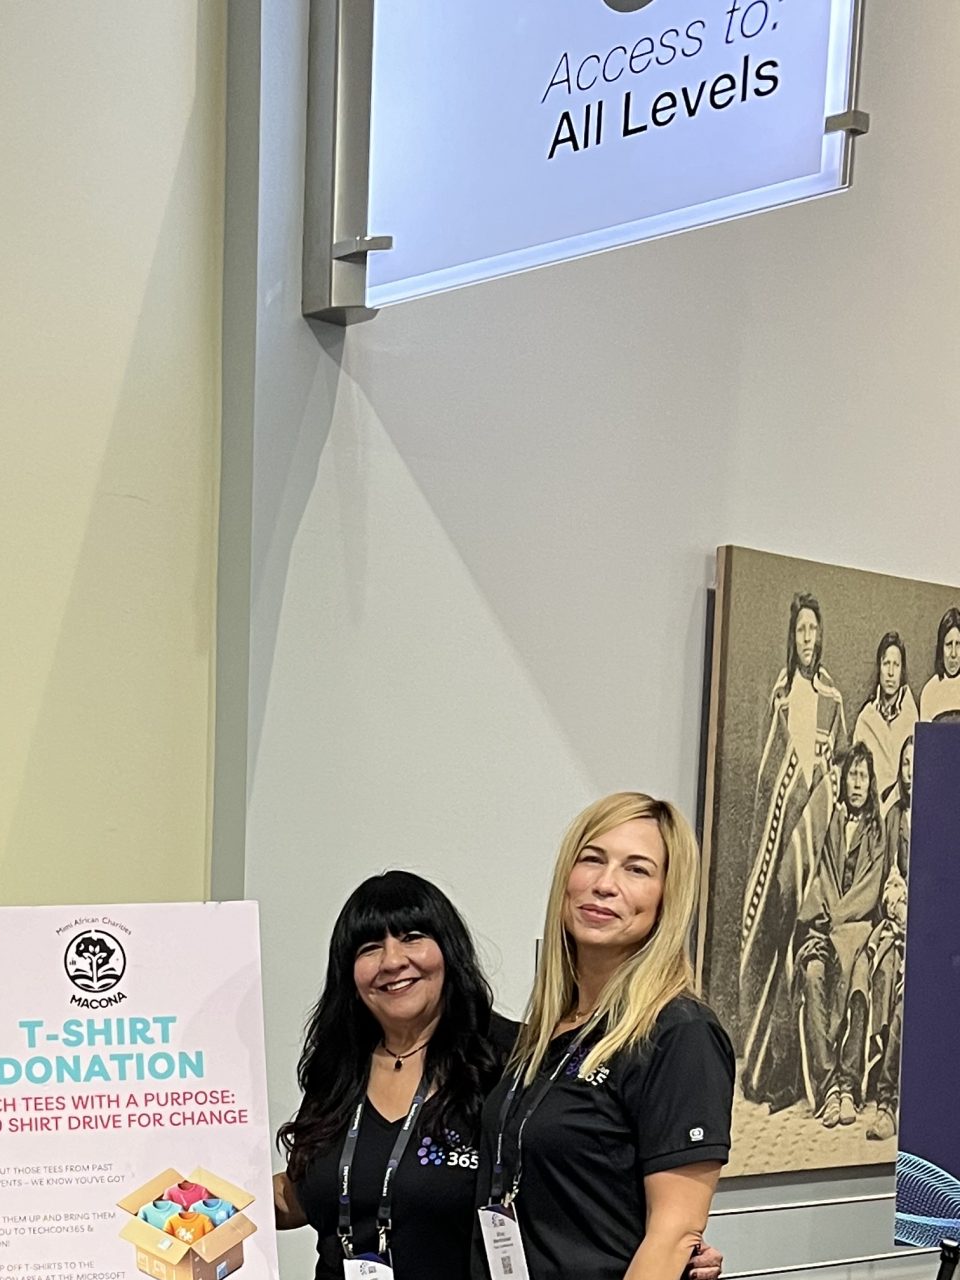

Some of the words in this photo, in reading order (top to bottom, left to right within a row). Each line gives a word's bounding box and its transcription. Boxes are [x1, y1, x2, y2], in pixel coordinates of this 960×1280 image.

[541, 20, 706, 104] Access
[547, 100, 603, 160] All
[622, 54, 779, 138] Levels
[56, 923, 74, 936] Mimi
[74, 917, 100, 926] African
[101, 916, 132, 936] Charities
[69, 991, 128, 1010] MACONA
[18, 1015, 177, 1048] T-SHIRT
[21, 1096, 66, 1112] TEES
[71, 1094, 120, 1110] WITH
[125, 1093, 139, 1108] A
[144, 1089, 236, 1107] PURPOSE:
[8, 1116, 62, 1132] SHIRT
[68, 1114, 122, 1130] DRIVE
[127, 1112, 164, 1128] FOR
[169, 1109, 248, 1126] CHANGE
[13, 1166, 41, 1175] THOSE
[44, 1165, 63, 1174] TEES
[65, 1164, 89, 1173] FROM
[91, 1163, 113, 1171] PAST
[446, 1151, 479, 1169] 365
[31, 1178, 44, 1186] WE
[46, 1177, 72, 1185] KNOW
[75, 1175, 105, 1184] YOU'VE
[107, 1175, 125, 1183] GOT
[2, 1215, 26, 1223] THEM
[29, 1214, 41, 1223] UP
[43, 1213, 62, 1221] AND
[63, 1212, 90, 1221] BRING
[92, 1212, 116, 1220] THEM
[14, 1227, 25, 1235] TO
[6, 1264, 22, 1272] OFF
[24, 1262, 62, 1271] T-SHIRTS
[64, 1262, 76, 1270] TO
[78, 1261, 95, 1269] THE
[76, 1271, 125, 1280] MICROSOFT
